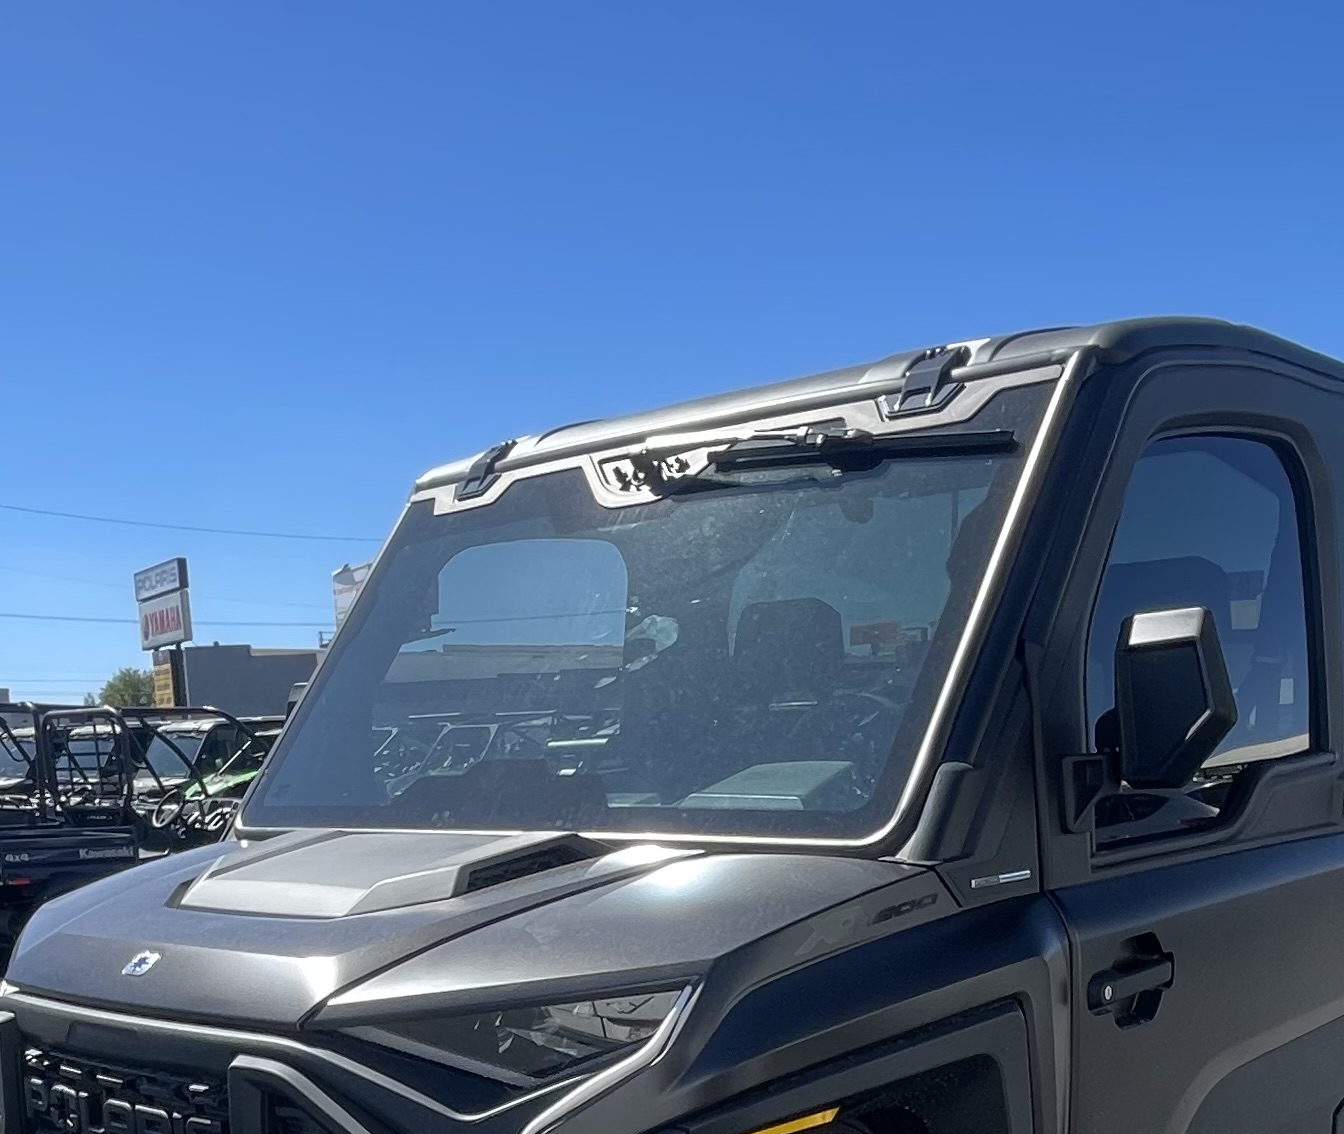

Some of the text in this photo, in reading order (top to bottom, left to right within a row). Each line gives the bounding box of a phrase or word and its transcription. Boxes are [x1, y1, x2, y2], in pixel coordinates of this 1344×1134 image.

[137, 566, 177, 592] POLARIS
[149, 604, 182, 637] YAMAHA
[5, 847, 134, 861] 4x4 Kawasaki
